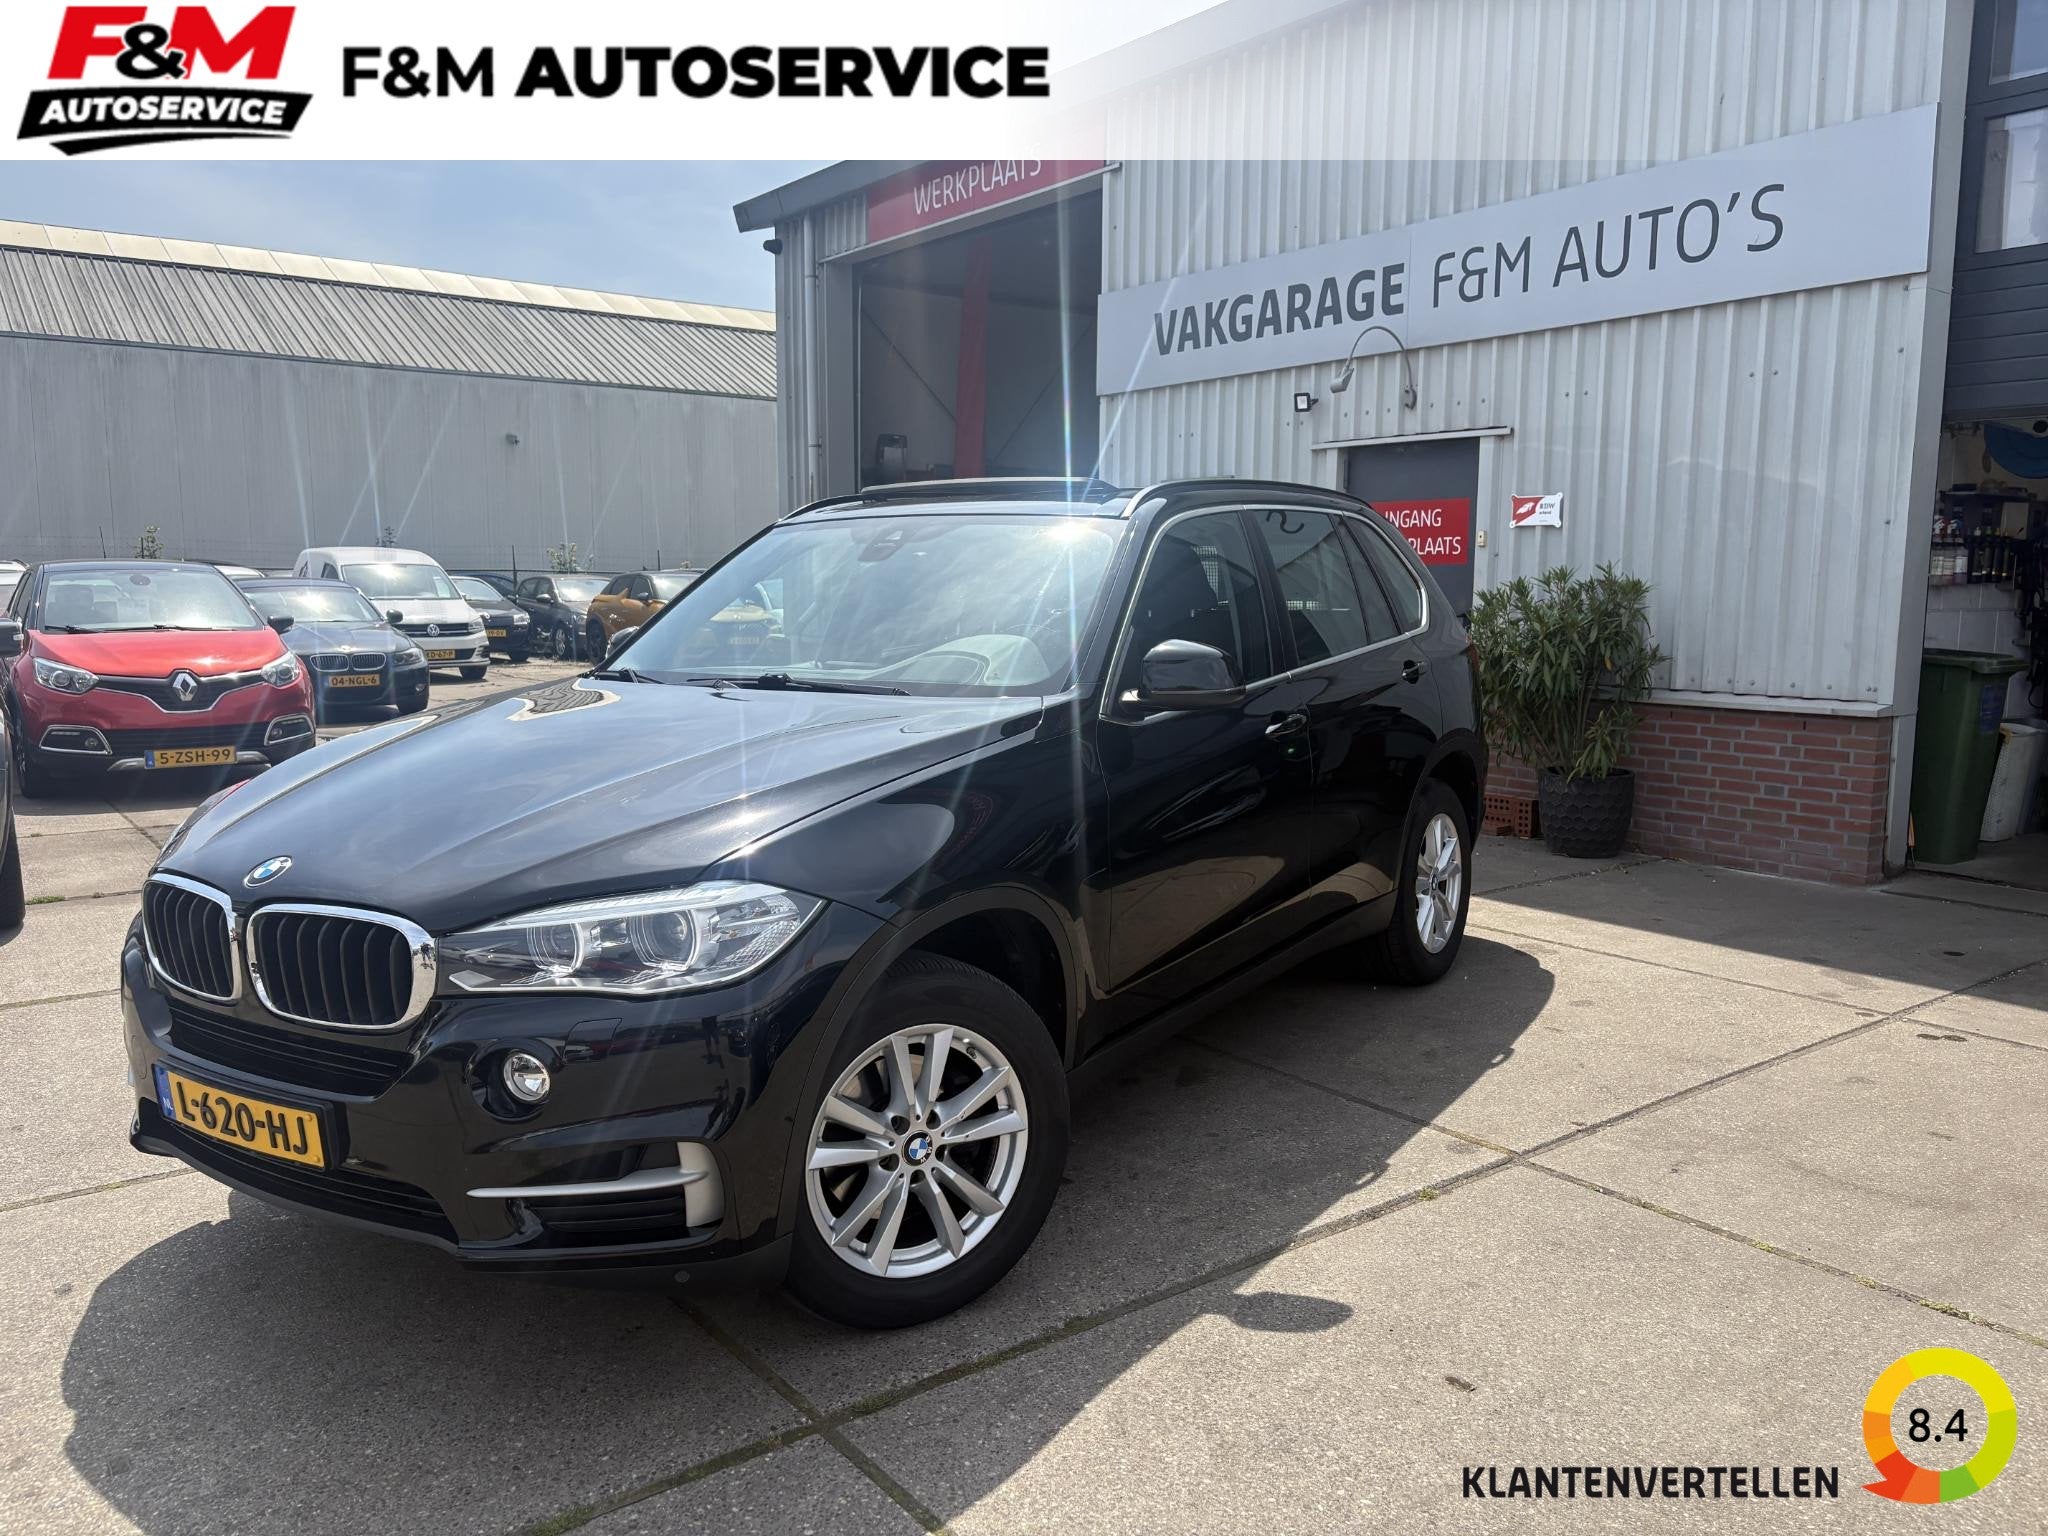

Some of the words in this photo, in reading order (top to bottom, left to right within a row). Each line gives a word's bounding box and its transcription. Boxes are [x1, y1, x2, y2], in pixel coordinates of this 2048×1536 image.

[1154, 263, 1405, 355] VAKGARAGE
[1433, 236, 1531, 308] F&M
[1553, 183, 1785, 287] AUTO'S
[160, 749, 231, 765] 5-ZSH-99
[176, 1081, 308, 1155] L-620-HJ
